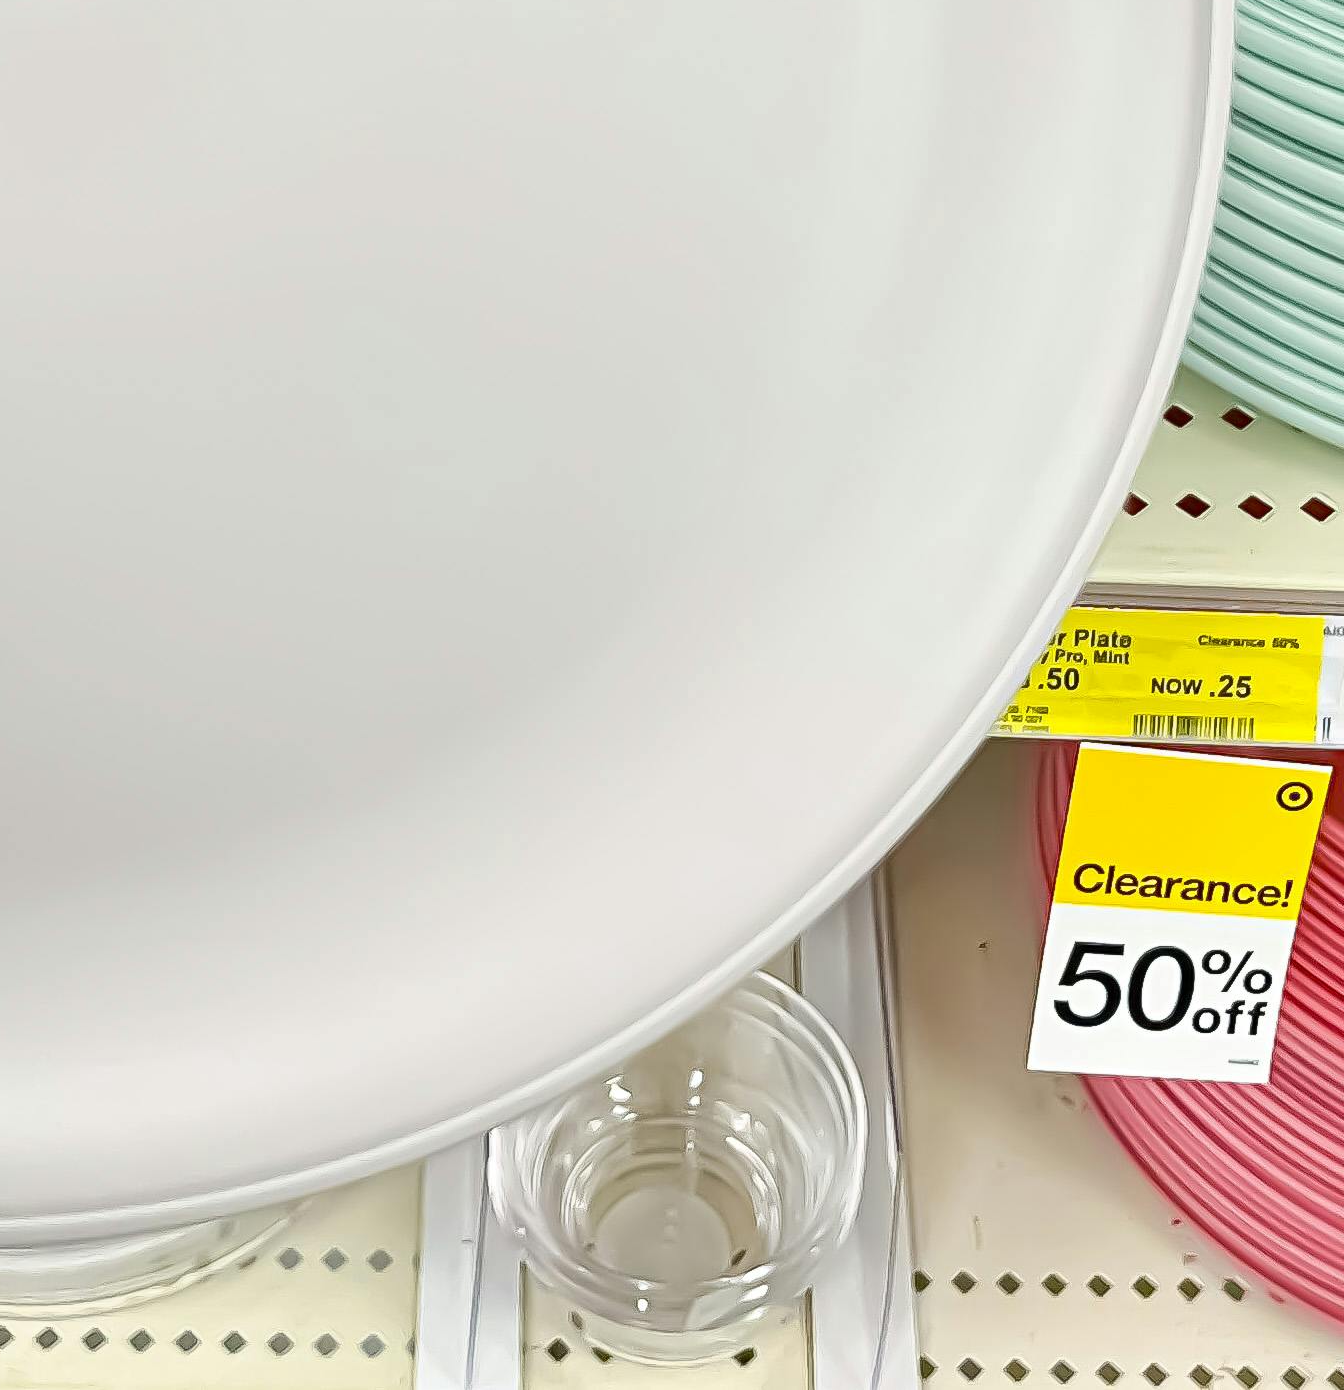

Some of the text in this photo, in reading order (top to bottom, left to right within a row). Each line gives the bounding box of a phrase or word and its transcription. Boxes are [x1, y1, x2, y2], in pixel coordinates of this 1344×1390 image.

[1074, 628, 1132, 649] Plate
[1197, 634, 1266, 648] Clearance
[1054, 648, 1088, 665] Pro,
[1093, 649, 1130, 665] Mint
[1037, 667, 1080, 691] .50
[1151, 674, 1252, 699] NOW .25
[1072, 862, 1294, 909] Clearance!
[1053, 940, 1274, 1032] 50%
[1191, 999, 1268, 1036] off
